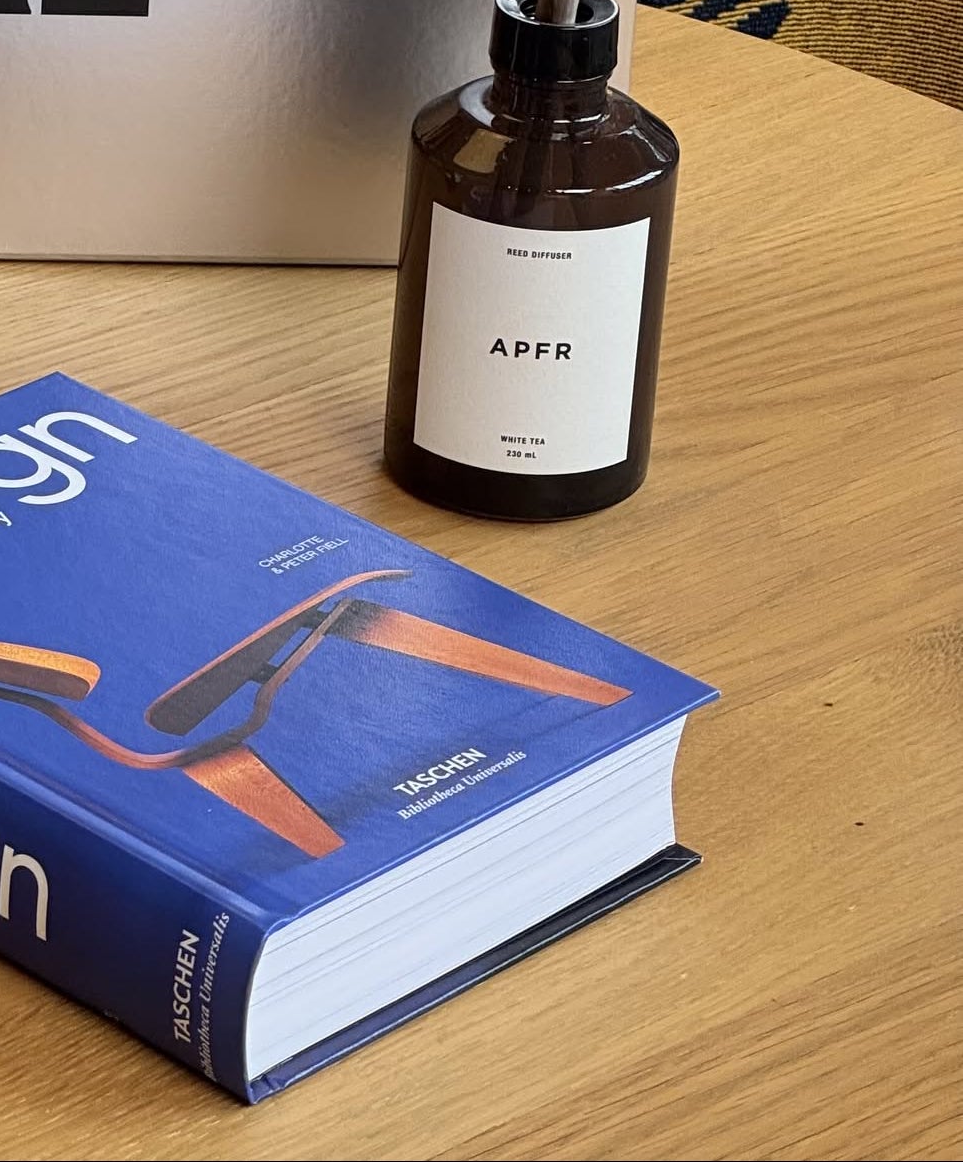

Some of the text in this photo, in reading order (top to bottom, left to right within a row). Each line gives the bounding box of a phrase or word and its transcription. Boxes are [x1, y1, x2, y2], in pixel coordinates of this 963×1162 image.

[507, 248, 572, 259] REED DIFFUSER
[489, 338, 572, 360] APFR
[500, 435, 545, 445] WHITE TEA
[506, 450, 521, 458] 230
[259, 535, 324, 568] CHARLOTTE
[271, 538, 350, 574] & PETER FIELL
[393, 747, 487, 796] TASCHEN
[397, 750, 527, 820] Bibliotheca Universalis
[199, 911, 231, 1002] Universalis
[173, 929, 200, 1044] TASCHEN
